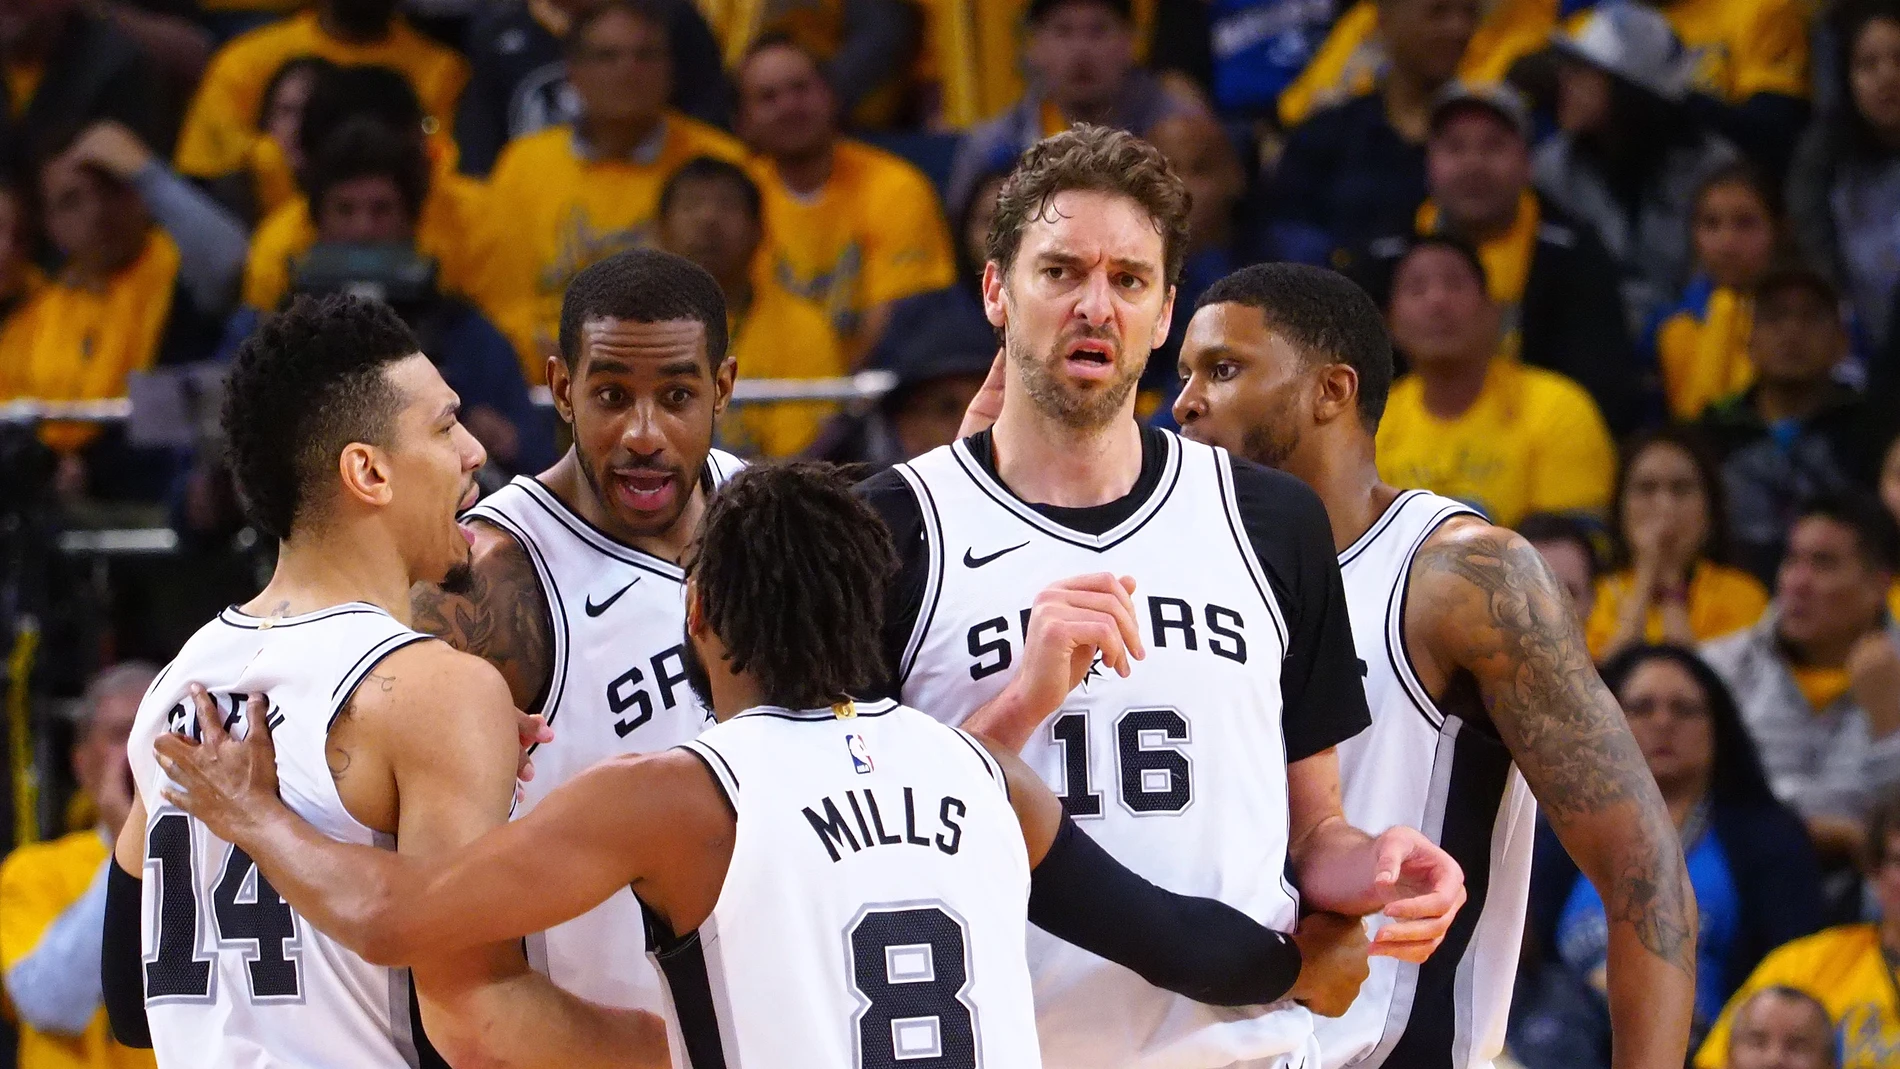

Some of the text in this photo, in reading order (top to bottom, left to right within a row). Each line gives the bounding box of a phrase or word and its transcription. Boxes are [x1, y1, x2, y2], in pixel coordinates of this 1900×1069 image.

[967, 595, 1248, 681] SRS
[1049, 705, 1196, 820] 16
[801, 786, 967, 863] MILLS
[143, 805, 307, 1007] 14
[841, 898, 985, 1069] 8
